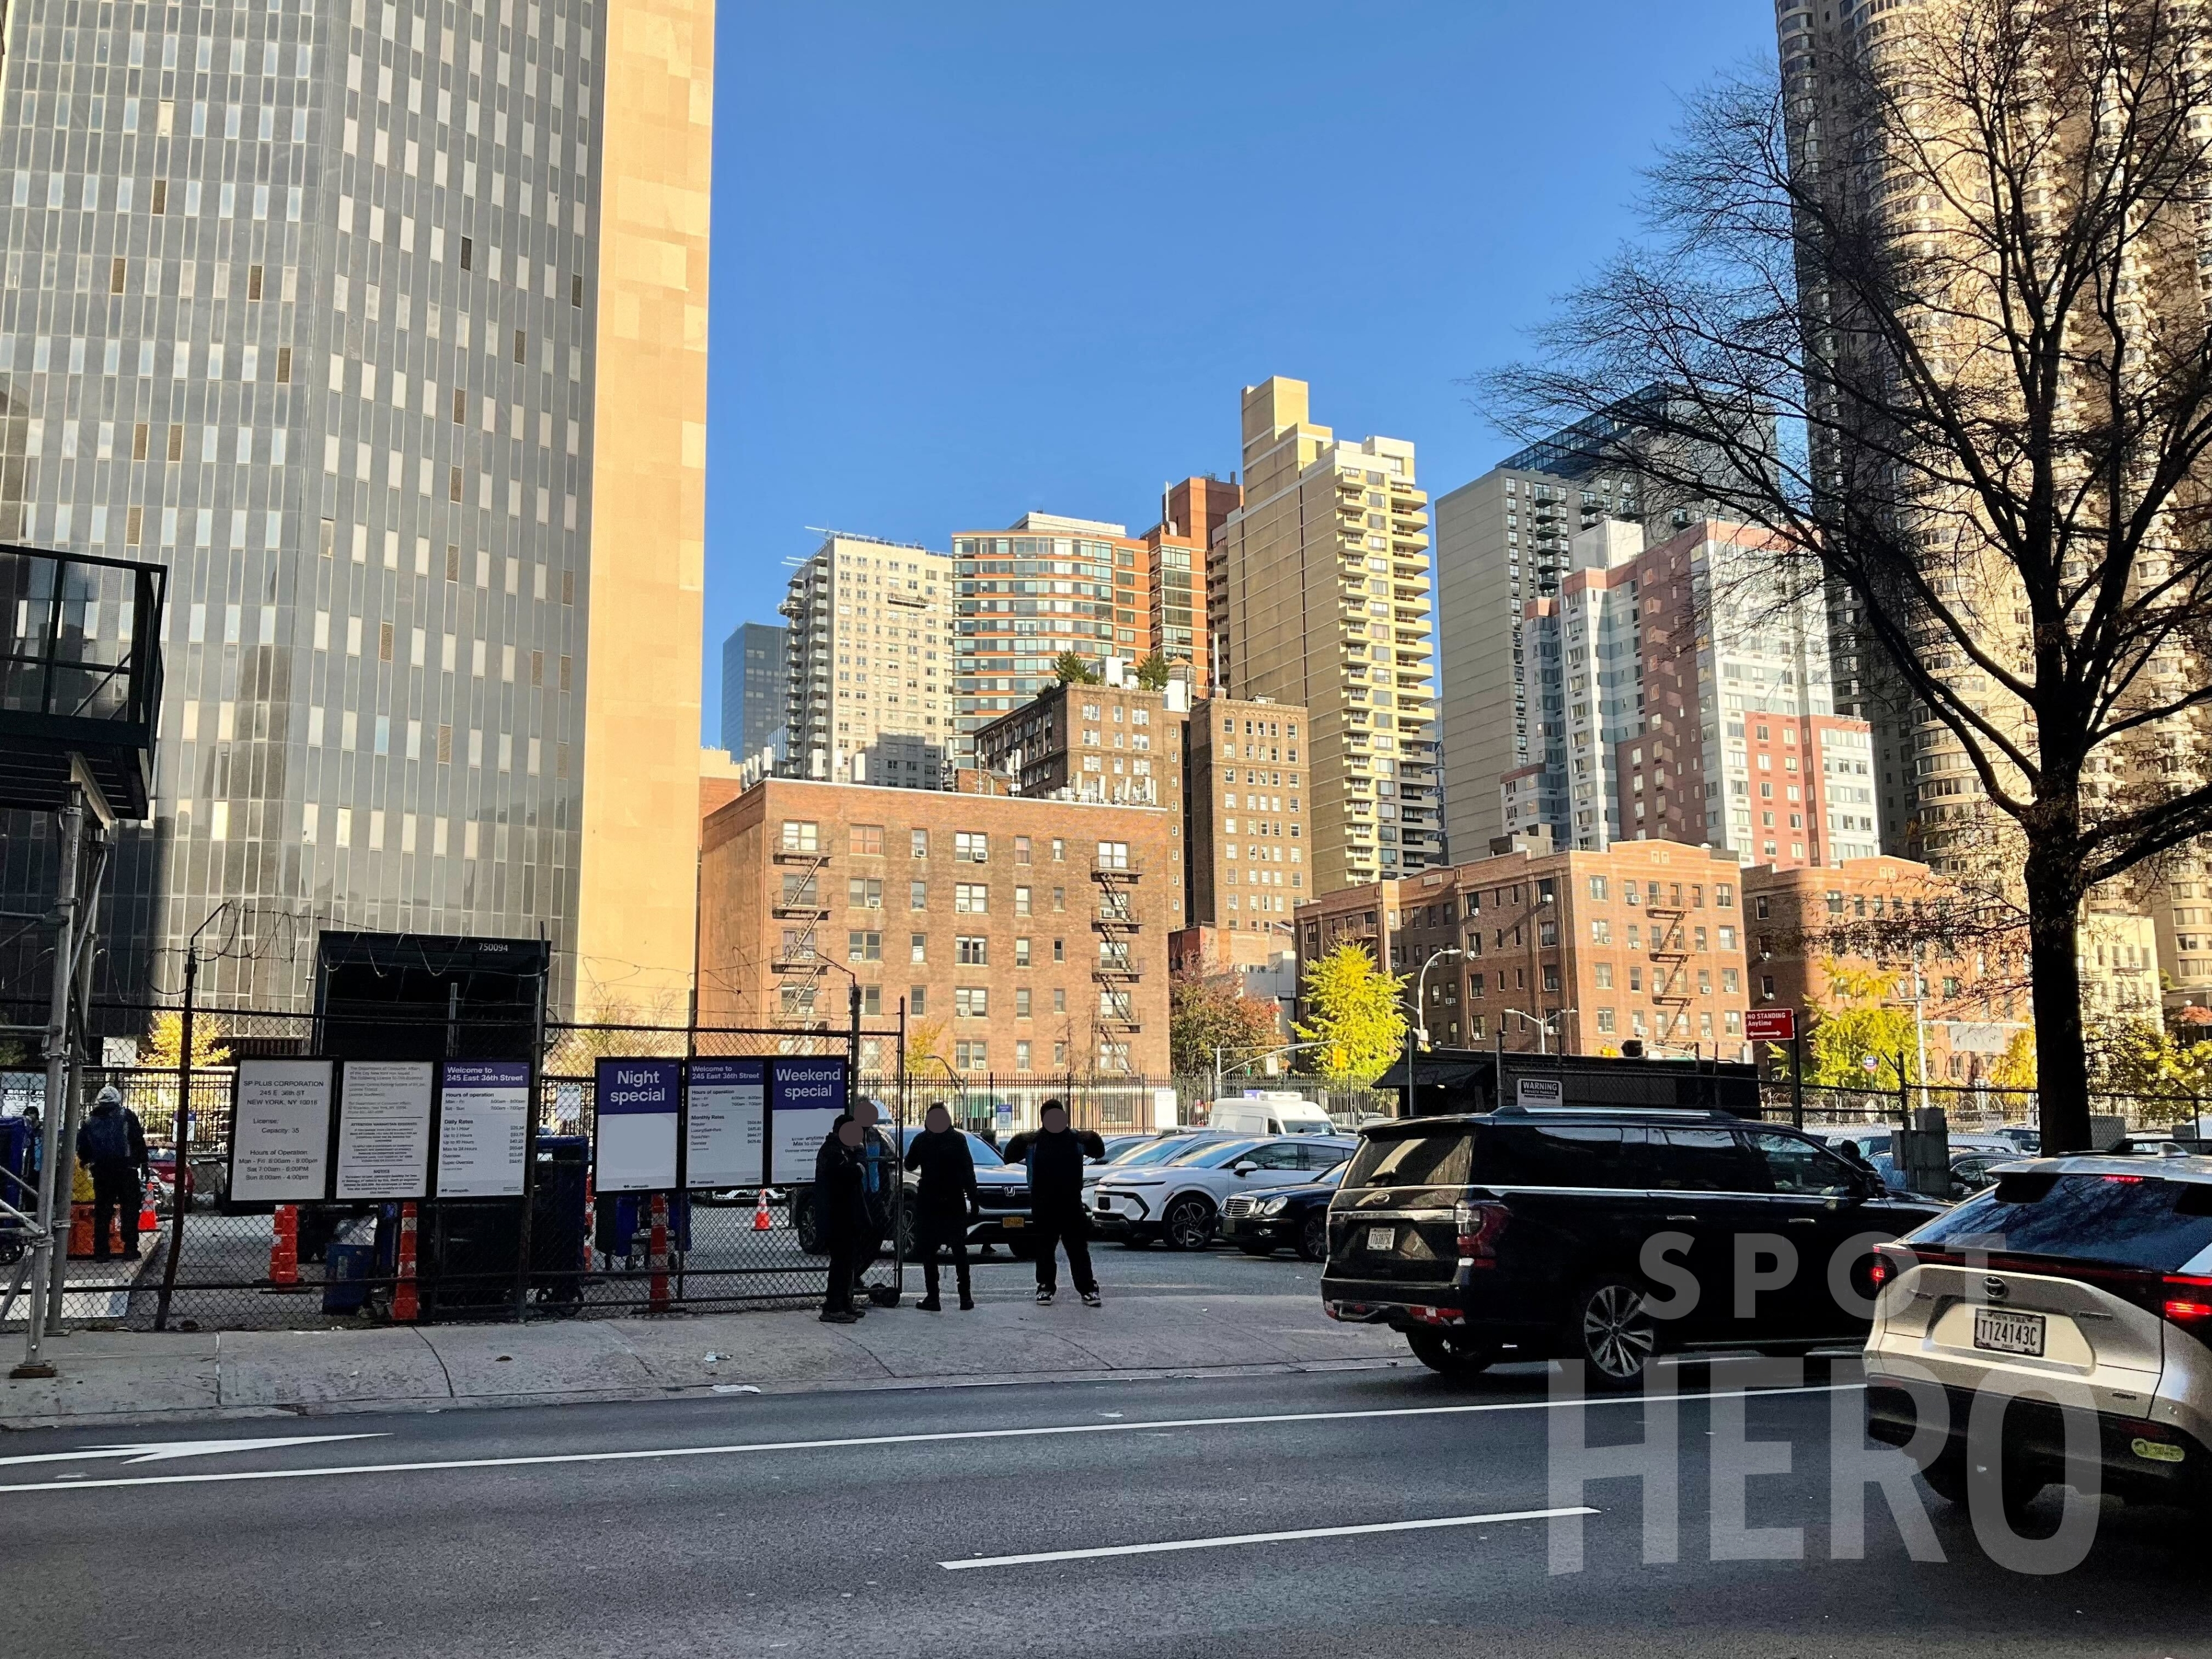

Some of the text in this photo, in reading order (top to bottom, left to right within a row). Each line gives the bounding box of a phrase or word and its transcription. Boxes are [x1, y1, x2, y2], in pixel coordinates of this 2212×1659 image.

[479, 943, 508, 952] 750094
[618, 1070, 660, 1087] Night
[777, 1069, 840, 1081] Weekend
[785, 1084, 832, 1100] special
[1523, 1081, 1557, 1090] WARNING
[611, 1088, 665, 1105] special
[1982, 1320, 2036, 1346] T124143C
